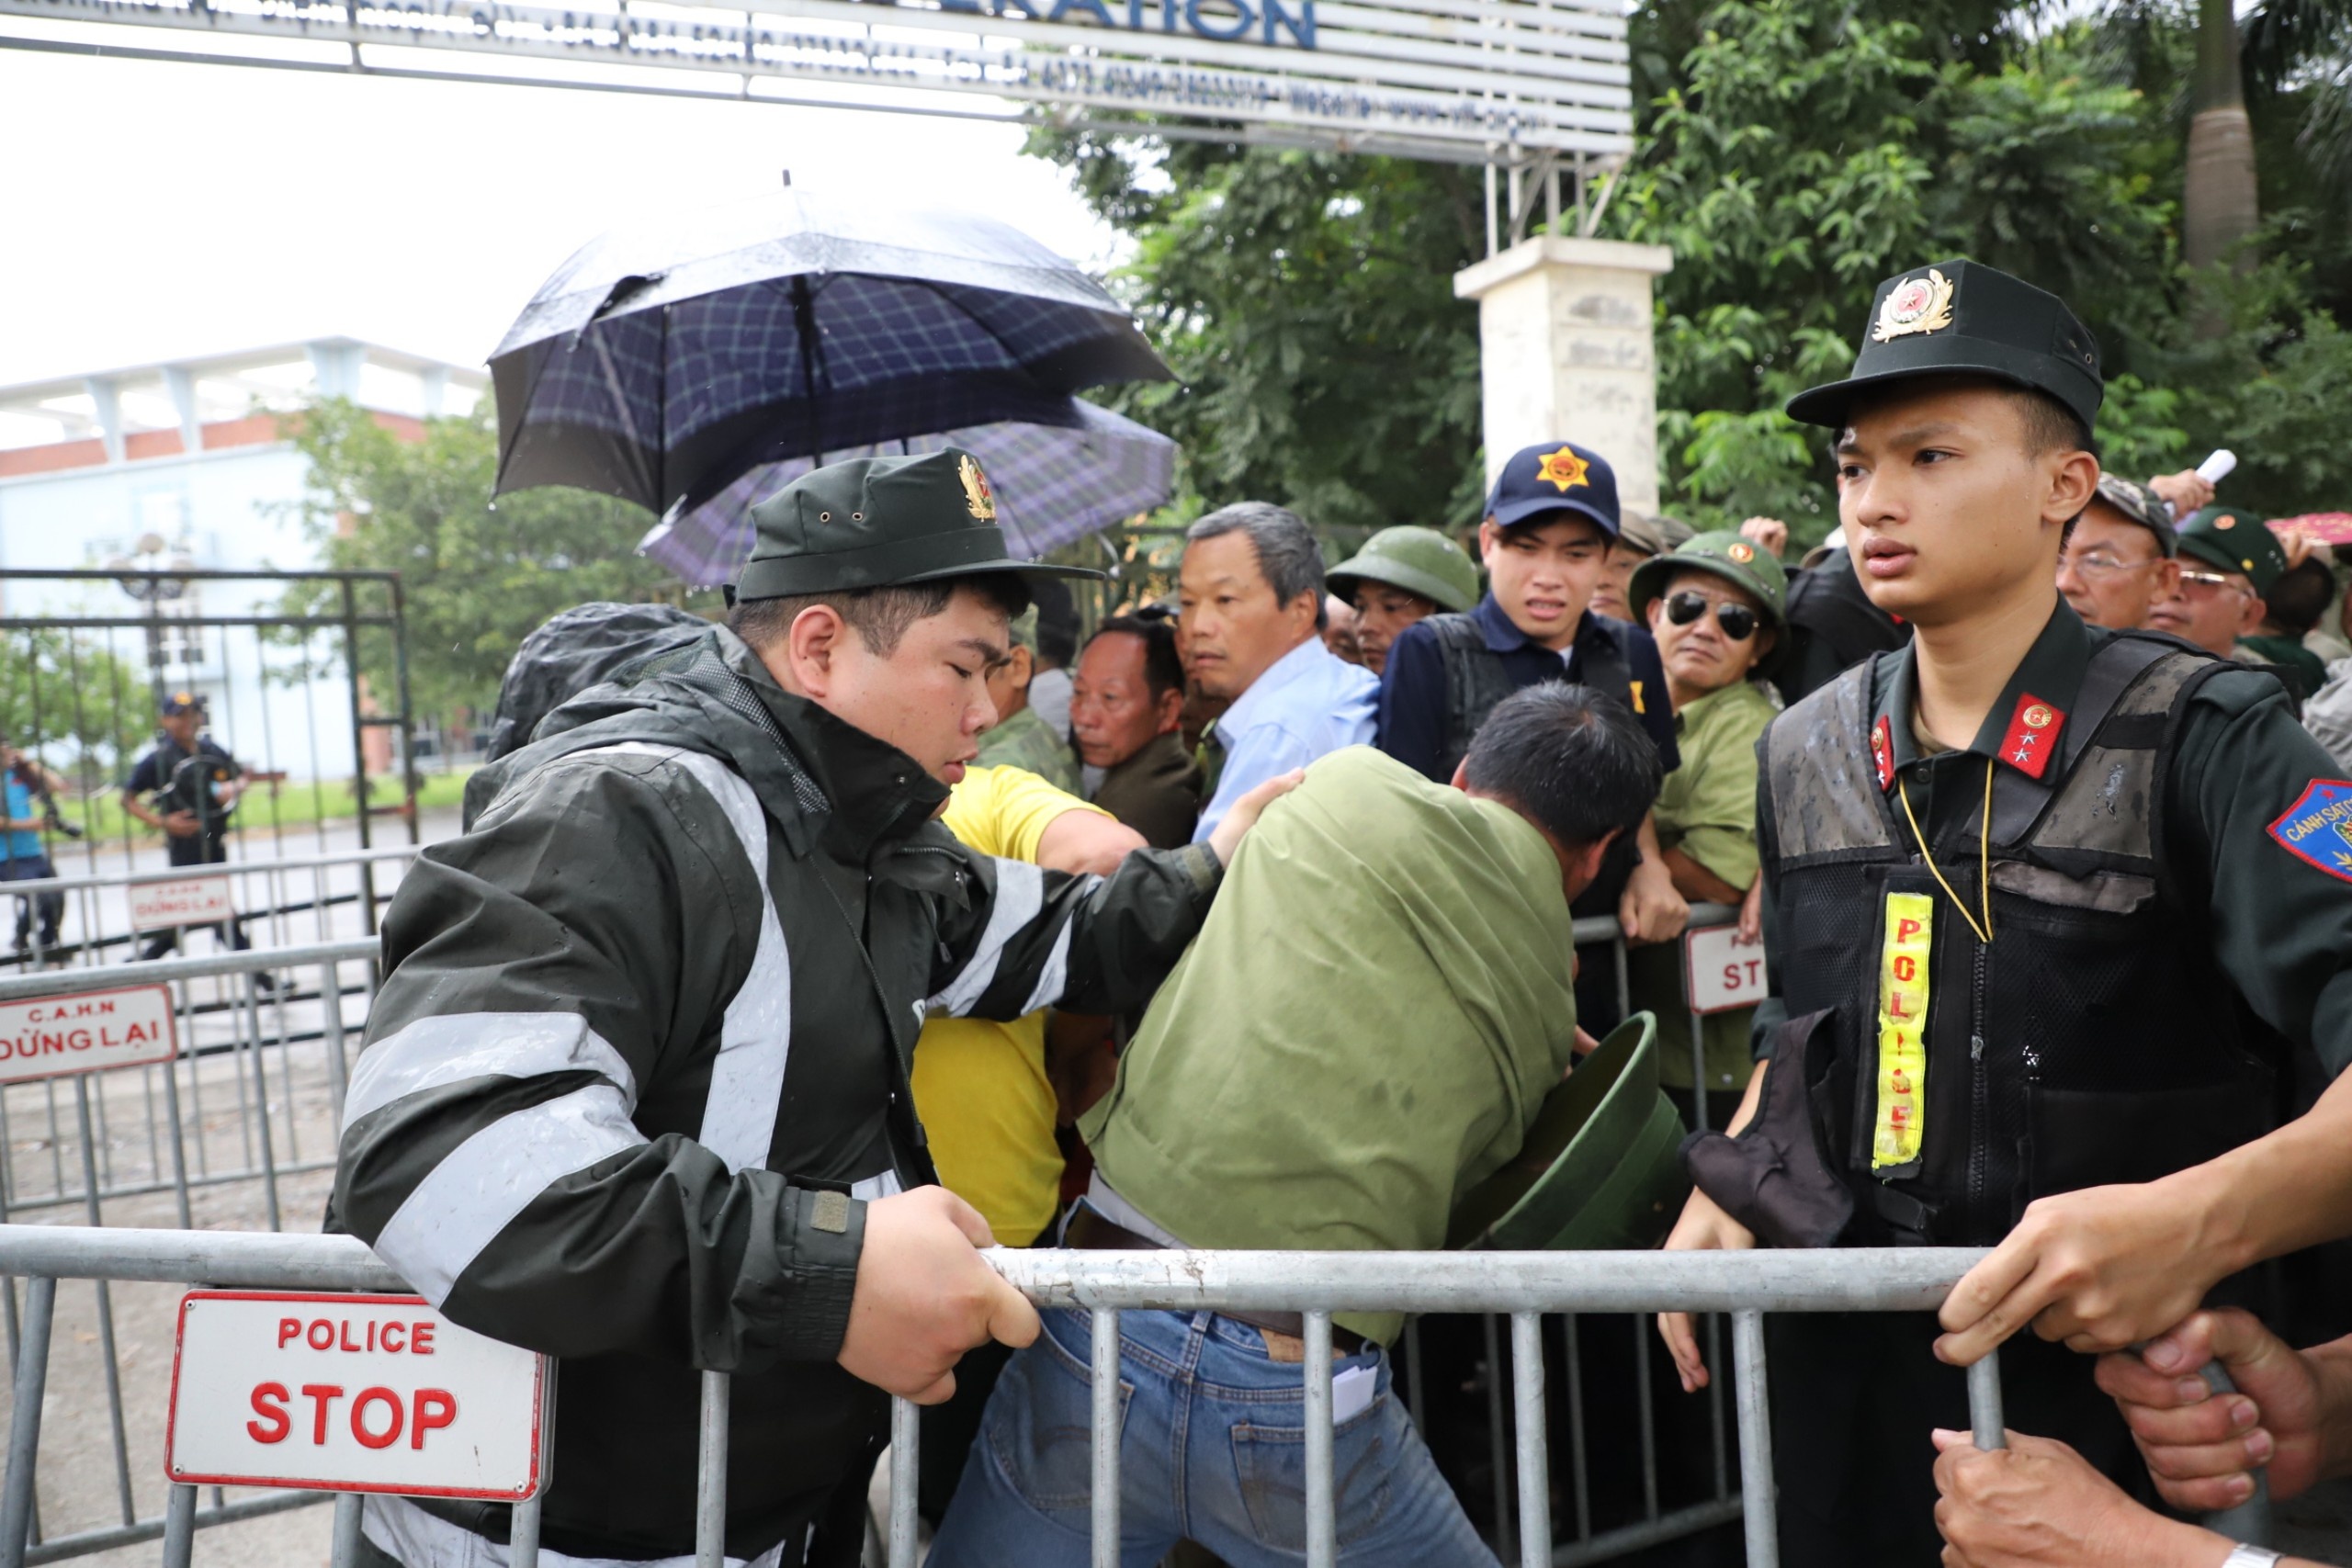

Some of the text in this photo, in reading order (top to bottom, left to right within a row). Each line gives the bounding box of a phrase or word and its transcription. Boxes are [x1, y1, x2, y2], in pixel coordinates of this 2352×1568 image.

[1724, 958, 1761, 990] ST
[100, 1021, 158, 1048] LẠI
[1889, 919, 1921, 1131] POLICE
[278, 1317, 435, 1355] POLICE
[246, 1381, 459, 1450] STOP
